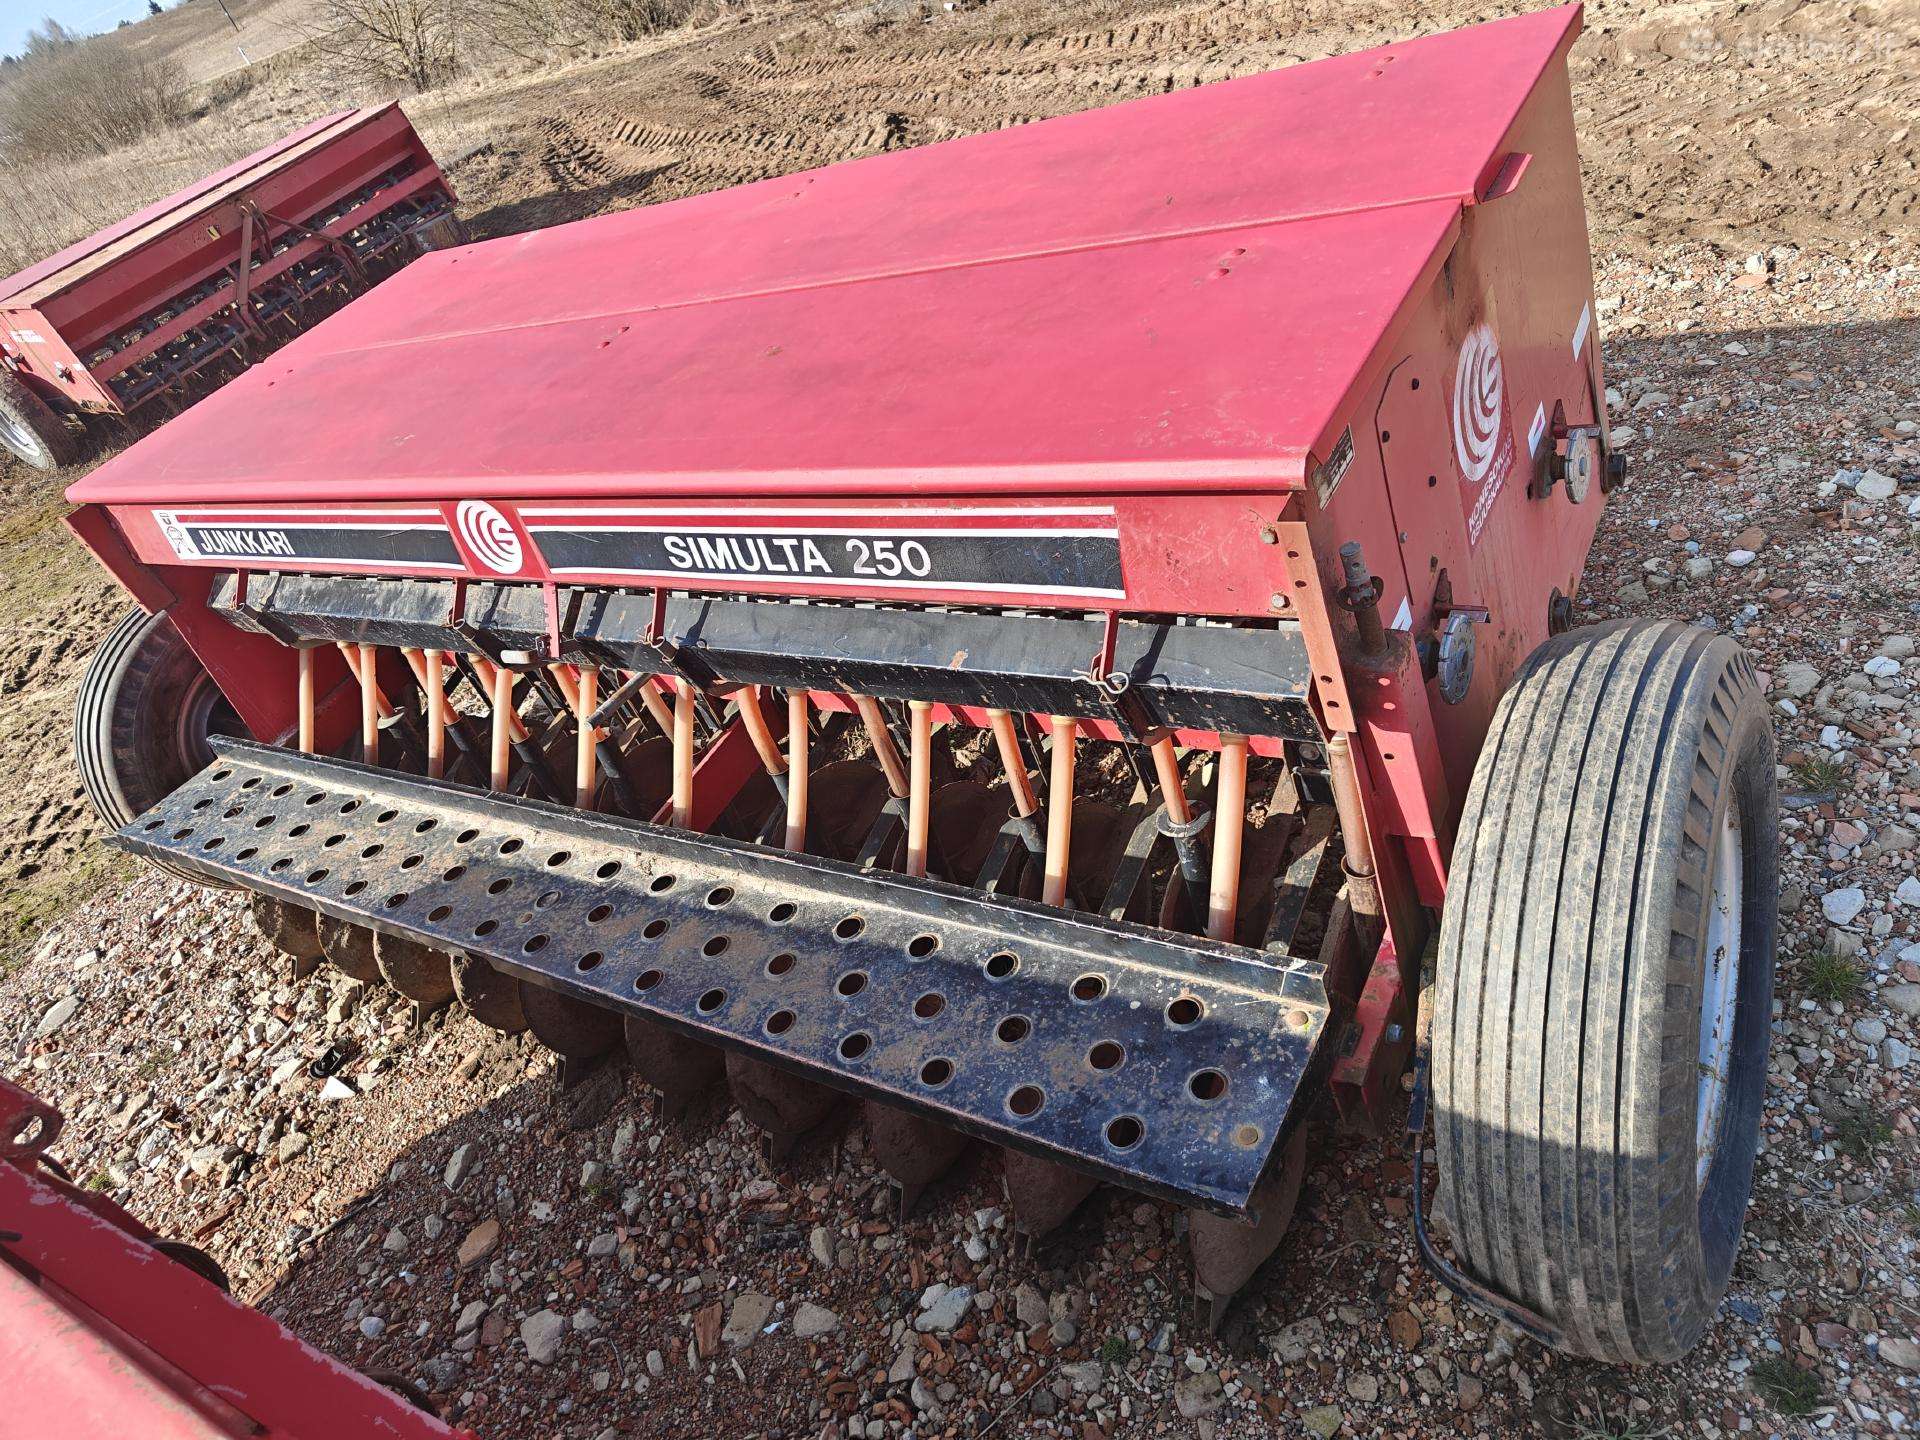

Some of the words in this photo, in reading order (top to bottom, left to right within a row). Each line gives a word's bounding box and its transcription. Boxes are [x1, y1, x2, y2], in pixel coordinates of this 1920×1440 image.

[198, 530, 296, 555] JUNKKARI
[663, 535, 833, 574] SIMULTA
[846, 538, 931, 577] 250
